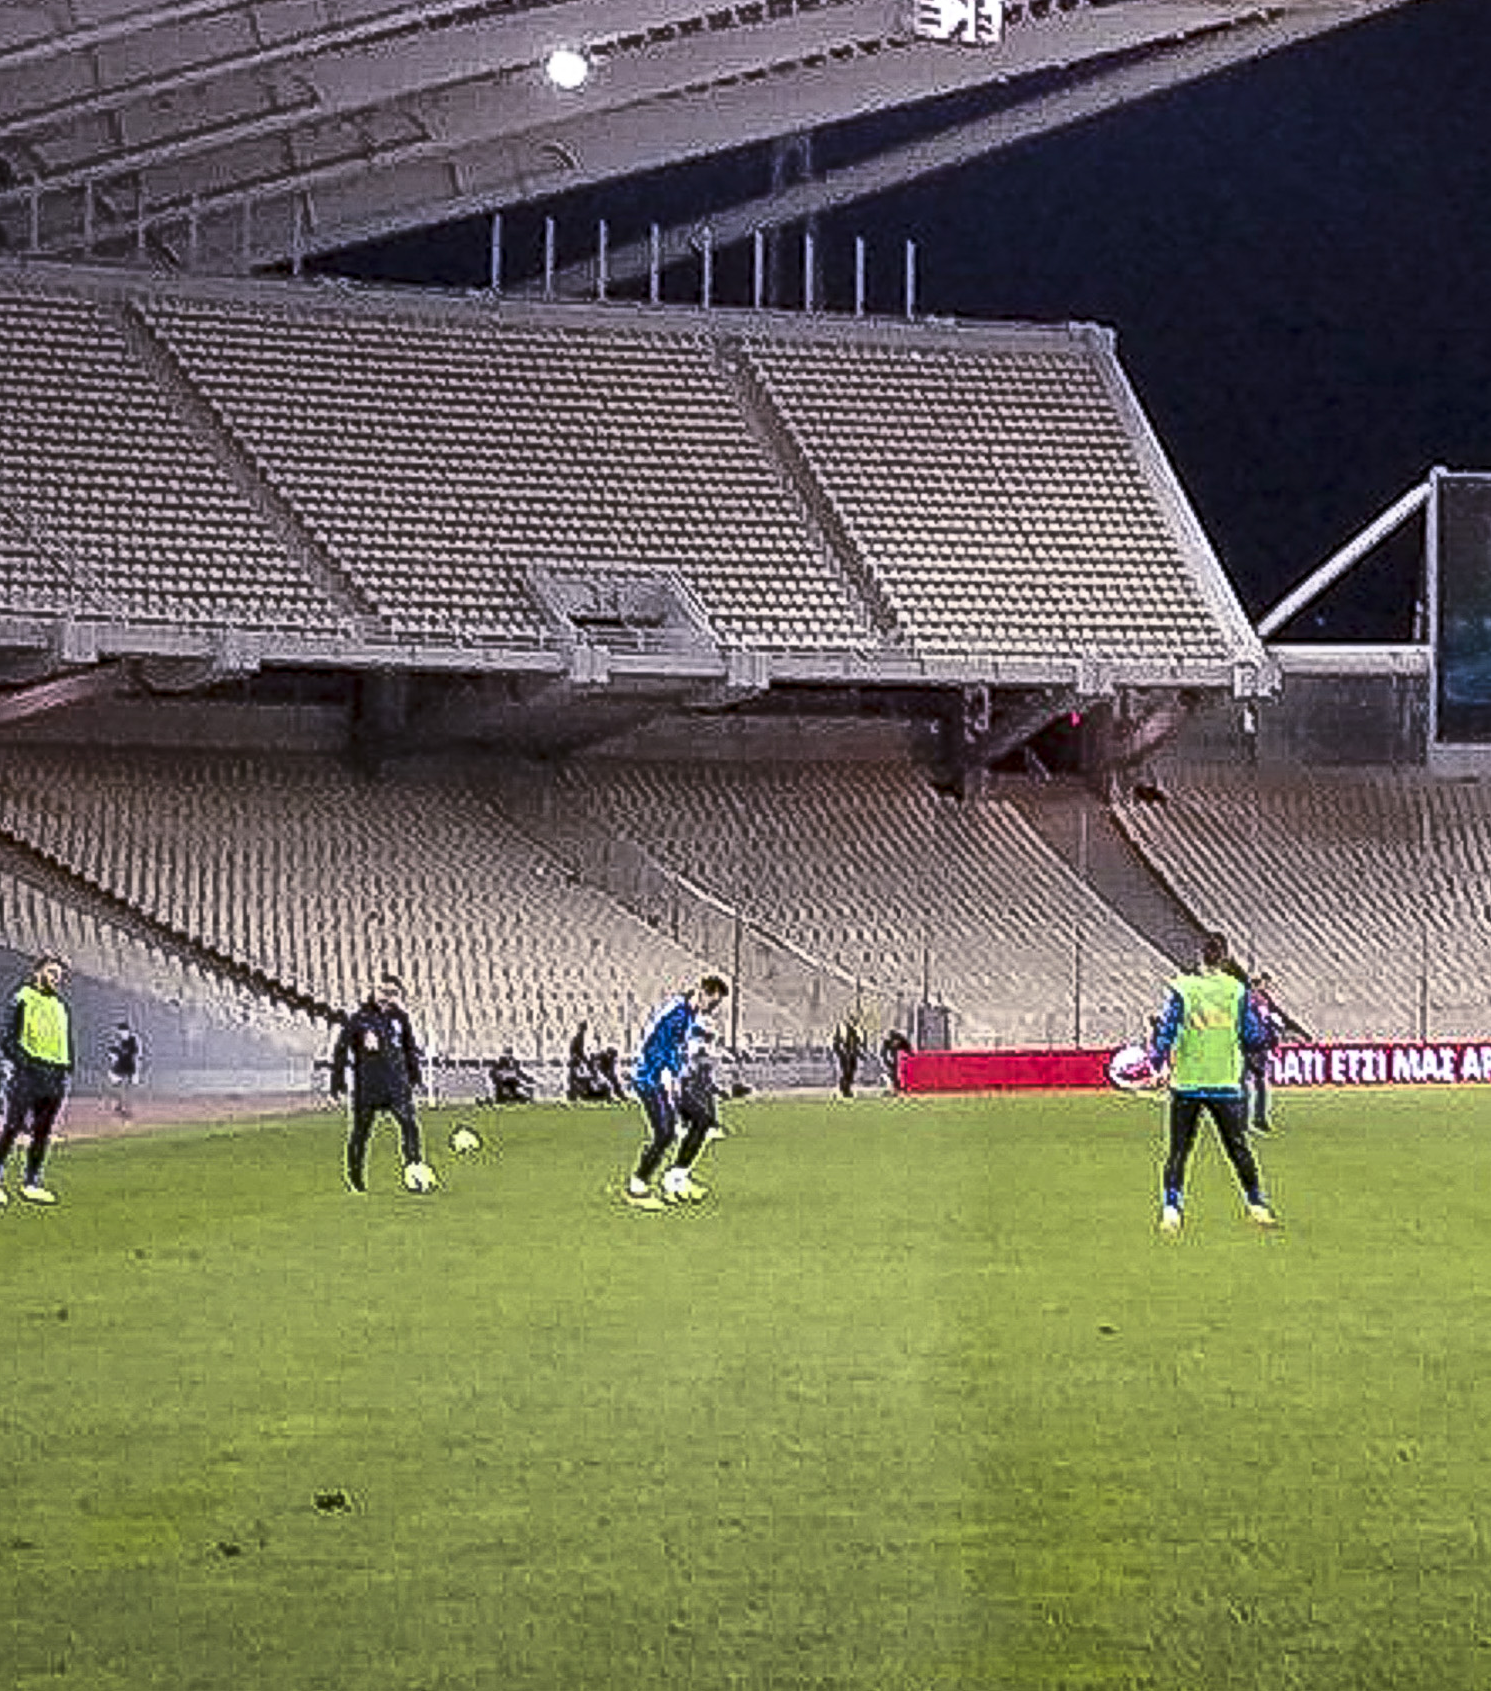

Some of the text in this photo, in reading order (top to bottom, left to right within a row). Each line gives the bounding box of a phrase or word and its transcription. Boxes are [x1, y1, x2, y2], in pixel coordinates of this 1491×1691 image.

[1267, 1048, 1325, 1084] ΙΑΤΙ
[1331, 1048, 1387, 1081] ΕΤΣΙ
[1392, 1047, 1457, 1082] ΜΑΣ
